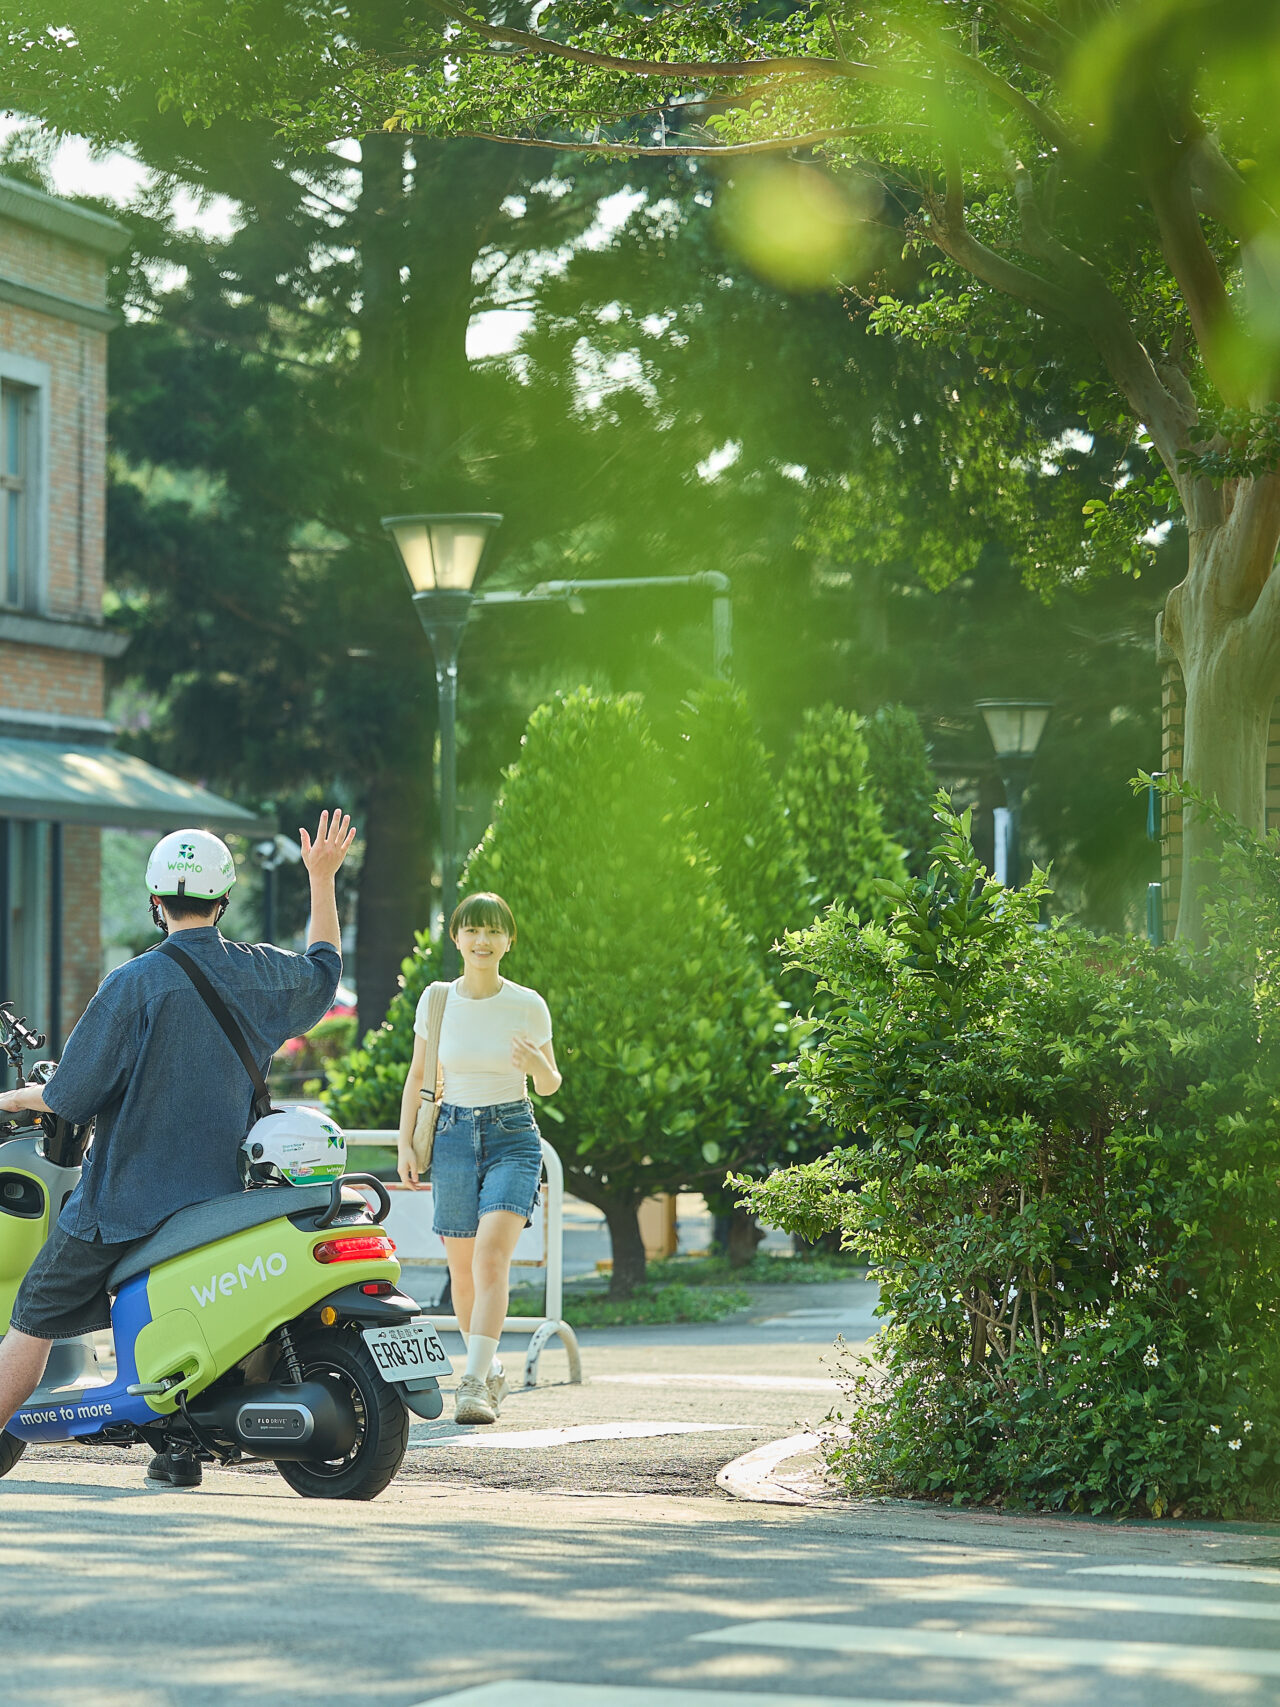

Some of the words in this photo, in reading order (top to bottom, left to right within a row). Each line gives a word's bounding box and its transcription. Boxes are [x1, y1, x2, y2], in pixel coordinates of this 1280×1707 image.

[20, 1410, 57, 1425] move
[60, 1406, 74, 1421] to
[77, 1403, 112, 1419] more
